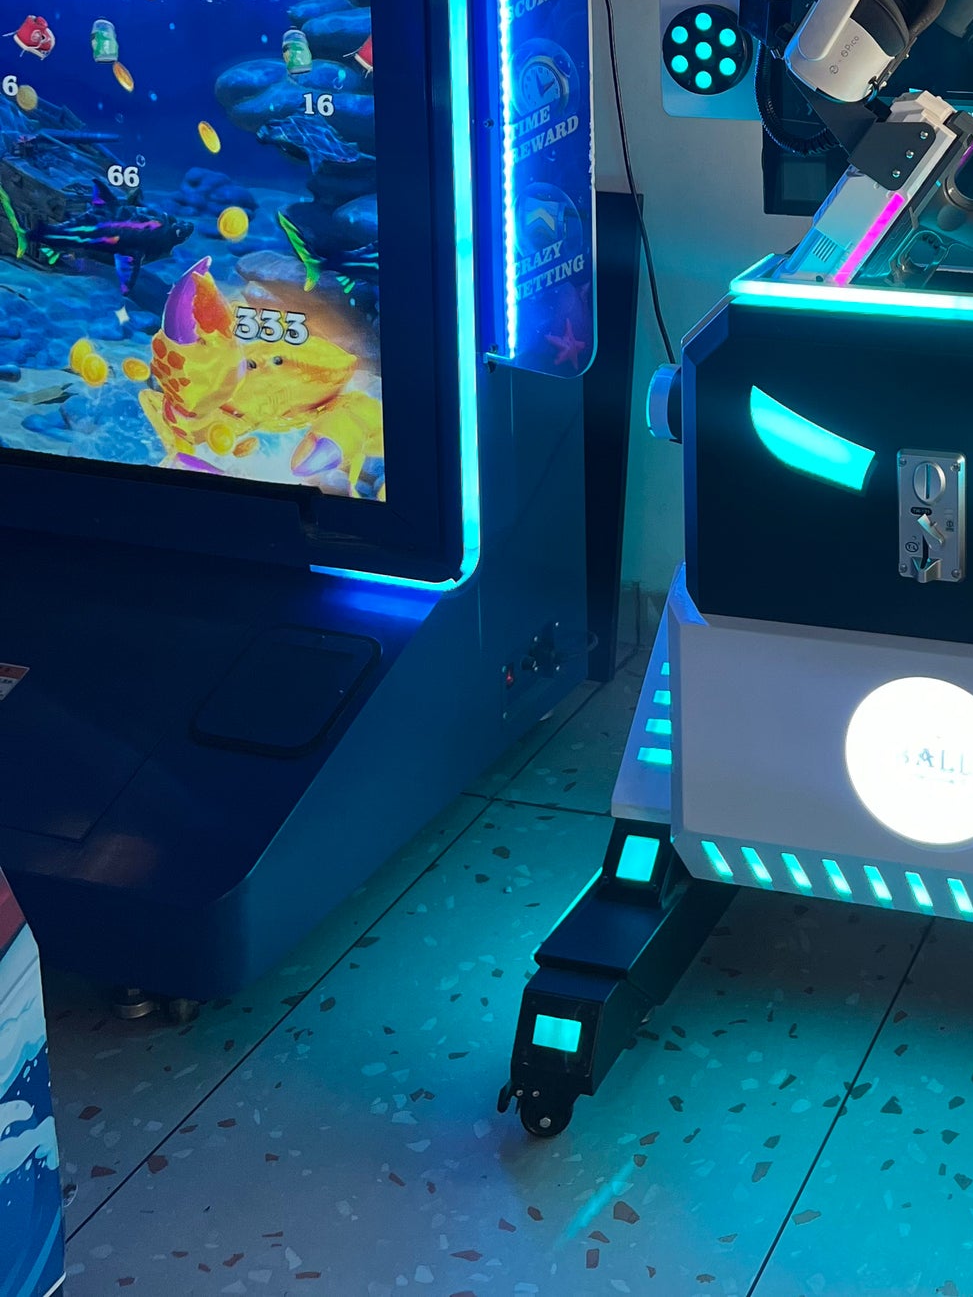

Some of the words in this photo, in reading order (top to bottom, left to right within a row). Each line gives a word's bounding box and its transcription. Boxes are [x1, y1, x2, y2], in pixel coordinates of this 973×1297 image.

[303, 93, 335, 117] 16
[107, 165, 140, 188] 66
[234, 306, 310, 345] 333
